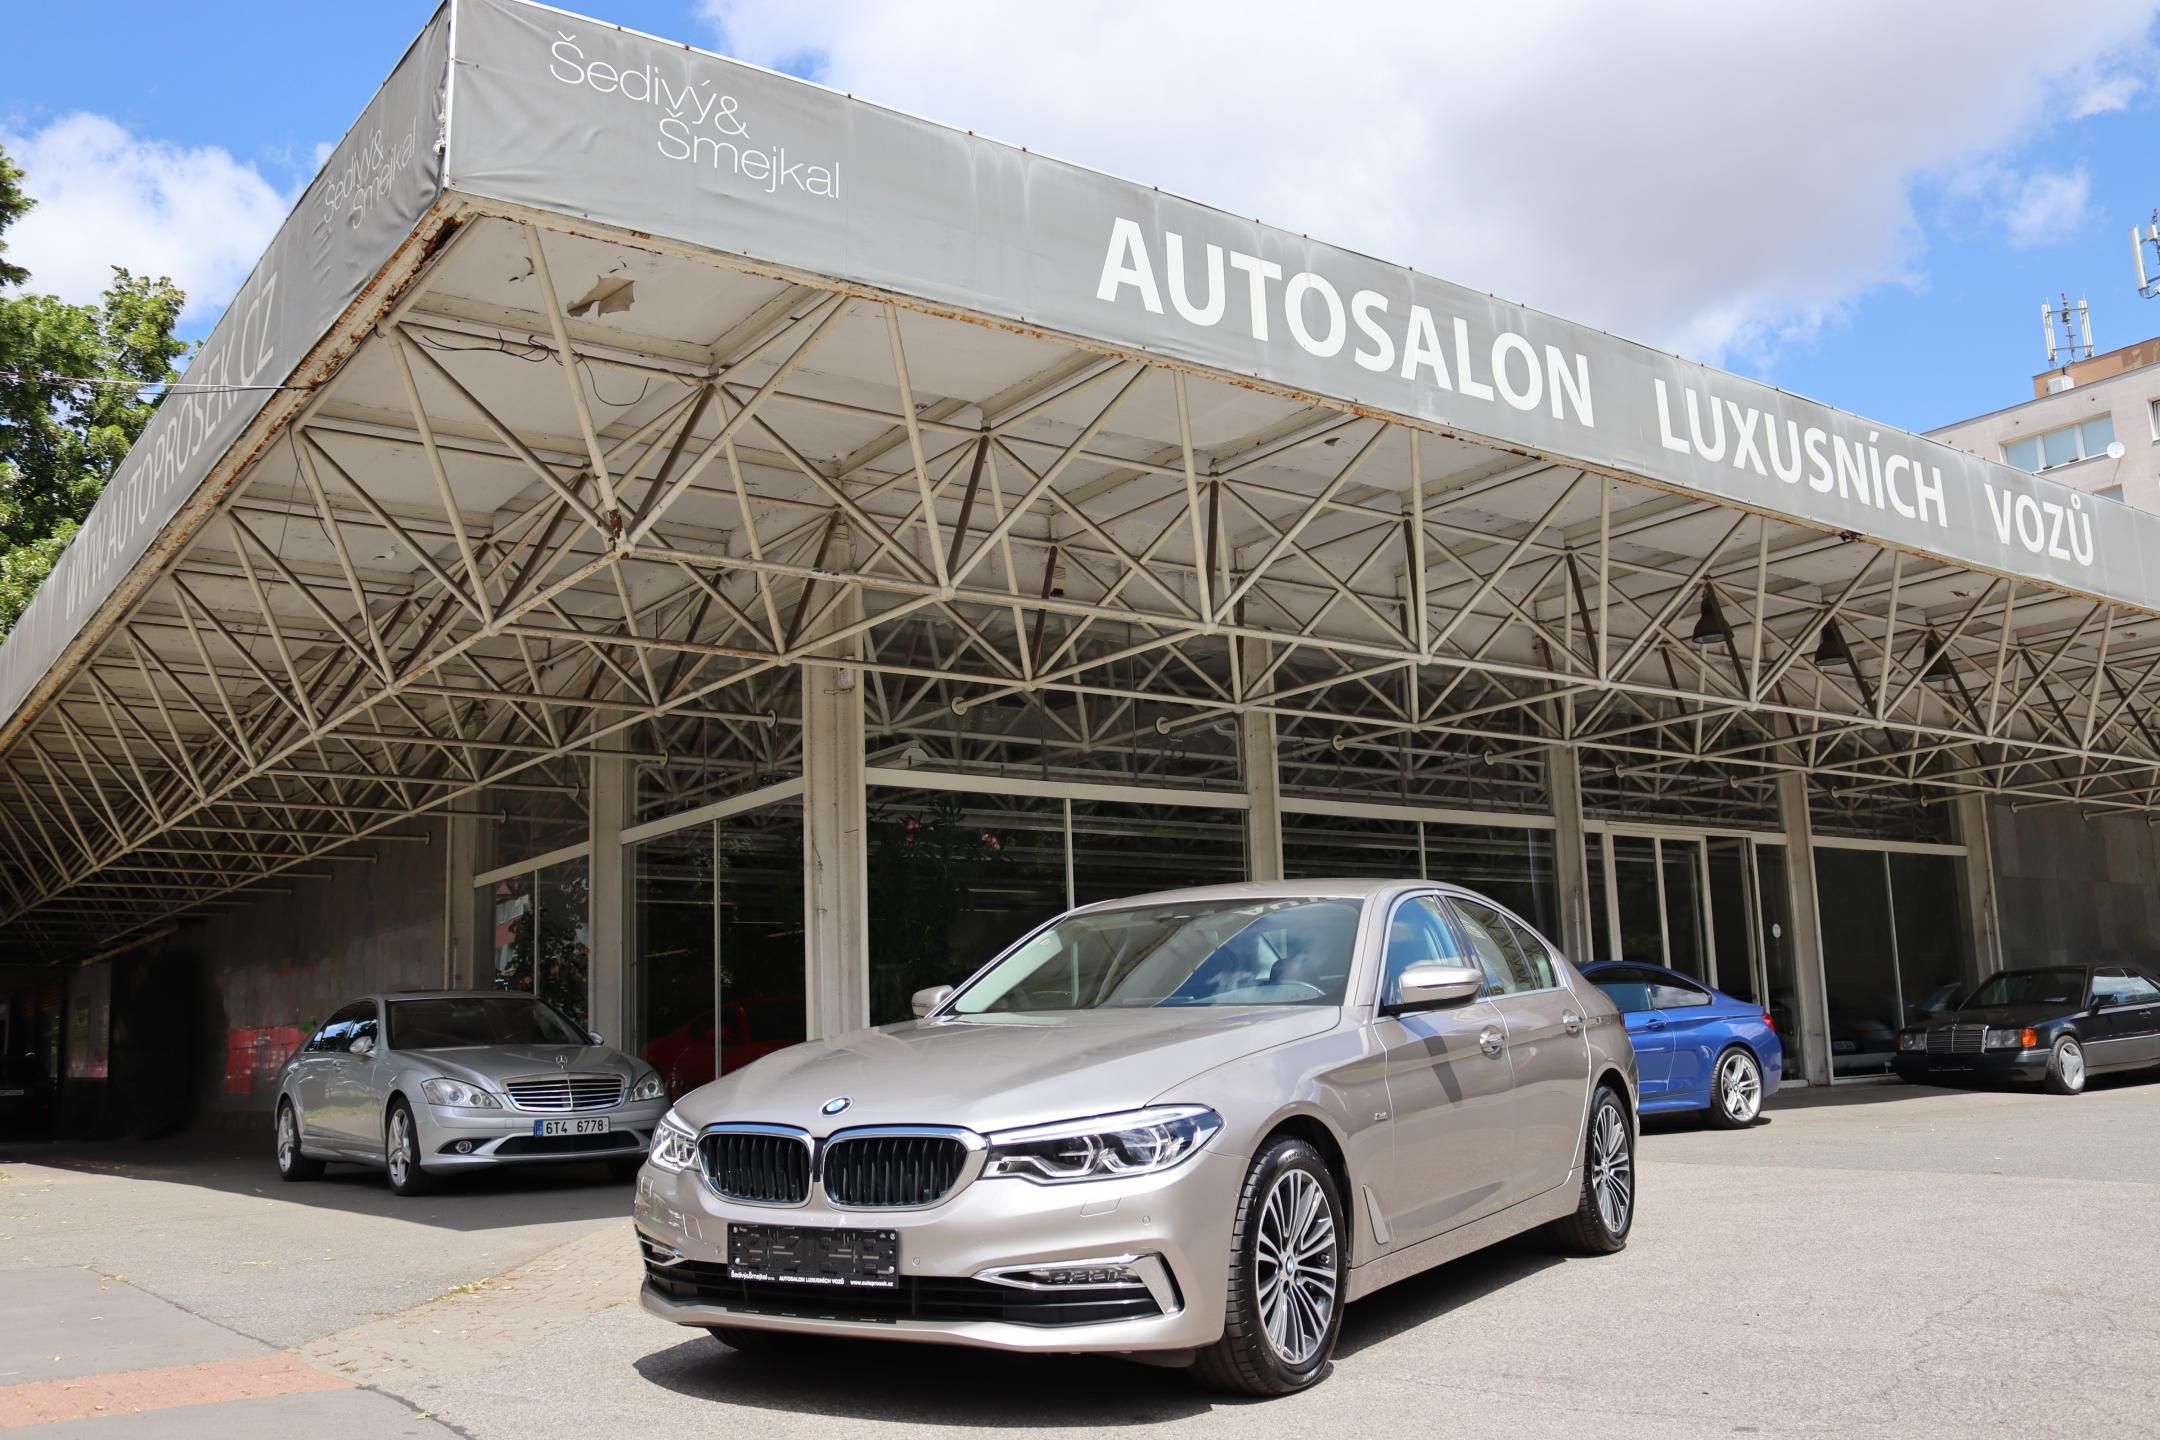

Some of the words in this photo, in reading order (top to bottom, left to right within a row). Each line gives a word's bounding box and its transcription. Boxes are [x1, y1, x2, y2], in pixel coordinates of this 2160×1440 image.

[549, 30, 751, 139] Šedivý&
[657, 110, 841, 199] Šmejkal
[1096, 216, 1595, 428] AUTOSALON
[1653, 378, 1948, 528] LUXUSNÍCH
[1984, 482, 2095, 568] VOZŮ
[546, 1122, 568, 1134] 6T4
[576, 1119, 604, 1132] 6778
